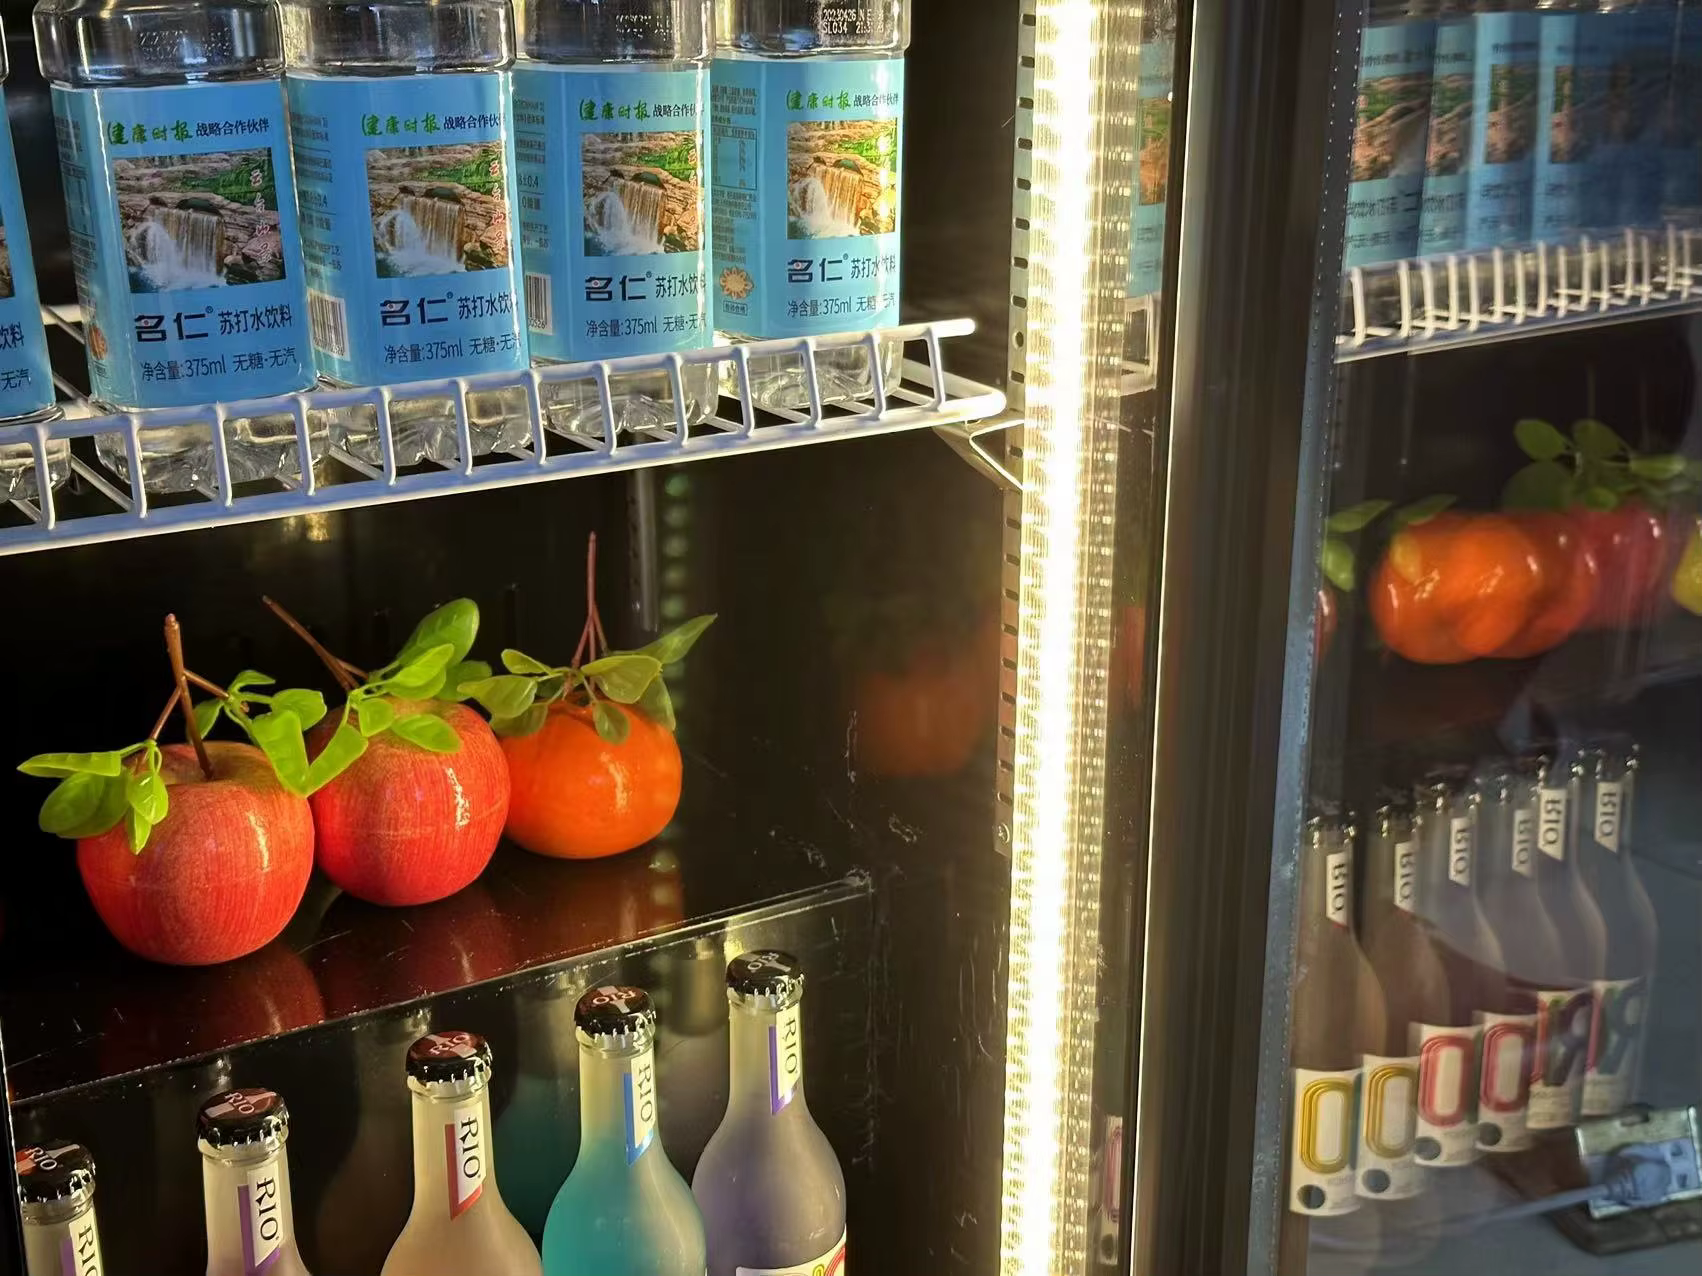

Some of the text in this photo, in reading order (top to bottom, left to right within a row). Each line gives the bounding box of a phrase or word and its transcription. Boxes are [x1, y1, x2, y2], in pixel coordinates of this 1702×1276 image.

[580, 99, 705, 121] 健康时报 战略合作伙
[787, 89, 851, 110] 健康时报
[107, 119, 193, 145] 健康时报
[196, 117, 269, 137] 战略合作伙伴
[361, 112, 441, 137] 健康时报
[787, 258, 843, 283] 名仁
[585, 275, 647, 301] 名仁
[380, 297, 449, 327] 名仁
[787, 296, 852, 318] 净含量:375ml
[134, 303, 293, 342] 名仁 苏打水饮料
[586, 315, 658, 338] 净含量:375ml
[384, 338, 463, 364] 净含量:375ml
[141, 354, 227, 382] 净含量:375ml
[593, 990, 637, 1005] RIO
[429, 1034, 470, 1055] RIO
[784, 1015, 798, 1075] RIO
[225, 1092, 255, 1114] RIO
[638, 1064, 653, 1122] RIO
[23, 1147, 58, 1170] RIO
[459, 1117, 481, 1179] RIO
[256, 1177, 279, 1241] RIO
